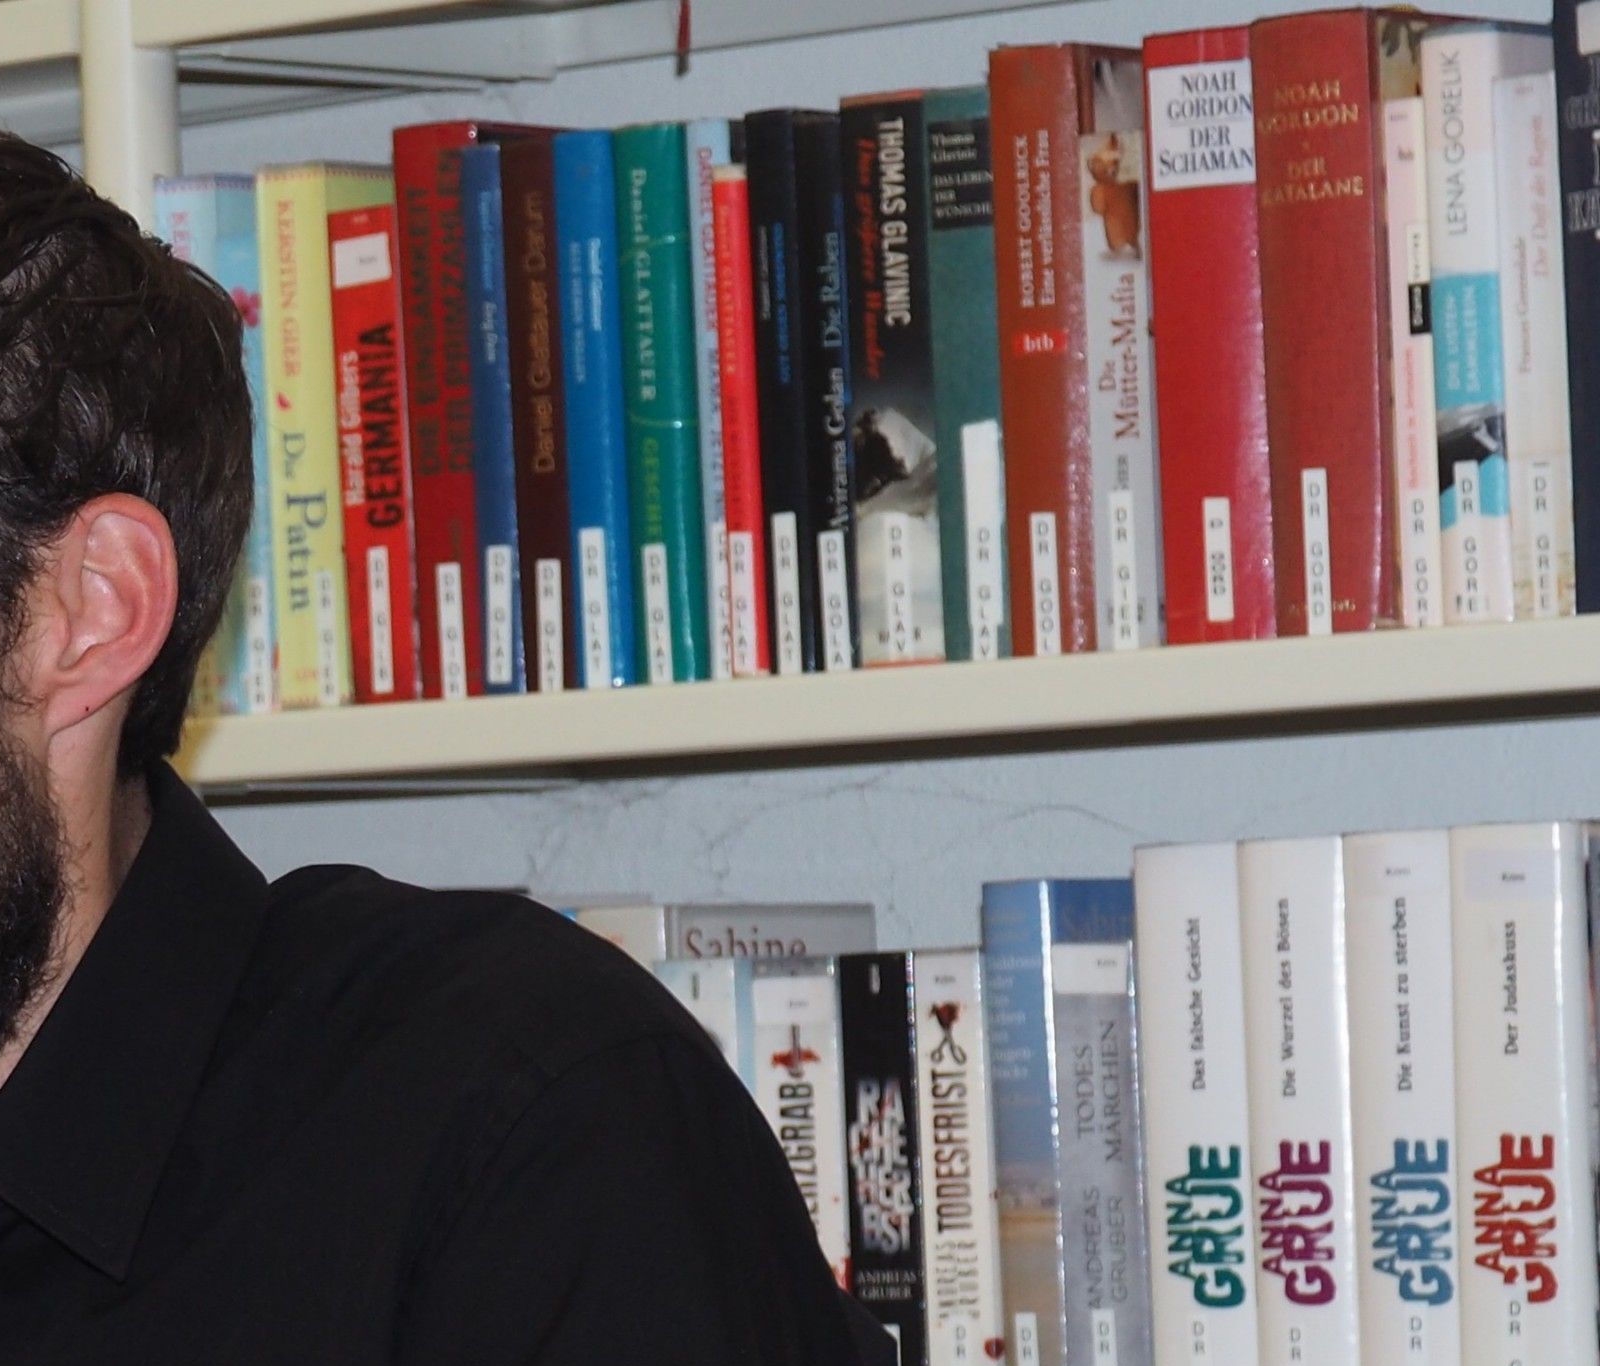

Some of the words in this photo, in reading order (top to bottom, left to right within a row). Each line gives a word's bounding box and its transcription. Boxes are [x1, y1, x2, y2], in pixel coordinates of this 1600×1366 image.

[1167, 93, 1254, 121] GORDON
[1182, 70, 1236, 94] NOAH
[1441, 49, 1466, 165] GORELIK
[877, 116, 907, 215] THOMAS
[1158, 147, 1254, 177] SCHAMAN
[1190, 125, 1231, 148] DER
[1446, 169, 1468, 236] LENA
[880, 218, 912, 328] GLAVINIC
[1018, 236, 1035, 308] ROBERT
[1097, 361, 1117, 392] Die
[1110, 272, 1141, 440] Mütter-Mafia
[282, 432, 306, 479] Die
[357, 322, 404, 529] GERMANIA
[342, 432, 366, 506] Harald
[1308, 482, 1321, 517] DR
[1461, 479, 1474, 514] DR
[286, 489, 328, 612] Patin
[1114, 507, 1128, 542] DR
[1186, 917, 1201, 981] Gesicht
[1392, 896, 1408, 967] sterben
[1278, 963, 1292, 992] des
[1395, 975, 1410, 997] zu
[1500, 920, 1519, 1016] Judaskuss
[1189, 990, 1206, 1052] falsche
[1279, 1000, 1296, 1062] Wurzel
[1396, 1001, 1412, 1057] Kunst
[1503, 1022, 1520, 1056] Der
[1074, 1044, 1097, 1140] TODES
[1191, 1066, 1207, 1091] Das
[1282, 1073, 1297, 1098] Die
[1397, 1063, 1413, 1092] Die
[930, 1066, 974, 1235] TODESFRIST
[1106, 1195, 1129, 1304] GRUBER
[1164, 1174, 1198, 1281] ANNA
[1187, 1143, 1247, 1309] GRUE
[1258, 1166, 1290, 1280] ANNA
[1278, 1137, 1337, 1307] GRUE
[1369, 1166, 1402, 1277] ANNA
[1392, 1136, 1455, 1307] GRUE
[1473, 1161, 1506, 1276] ANNA
[1498, 1132, 1559, 1306] GRUE
[1192, 1320, 1206, 1355] DR
[1290, 1326, 1302, 1362] DR
[1409, 1315, 1423, 1351] DR
[1509, 1300, 1522, 1337] DR
